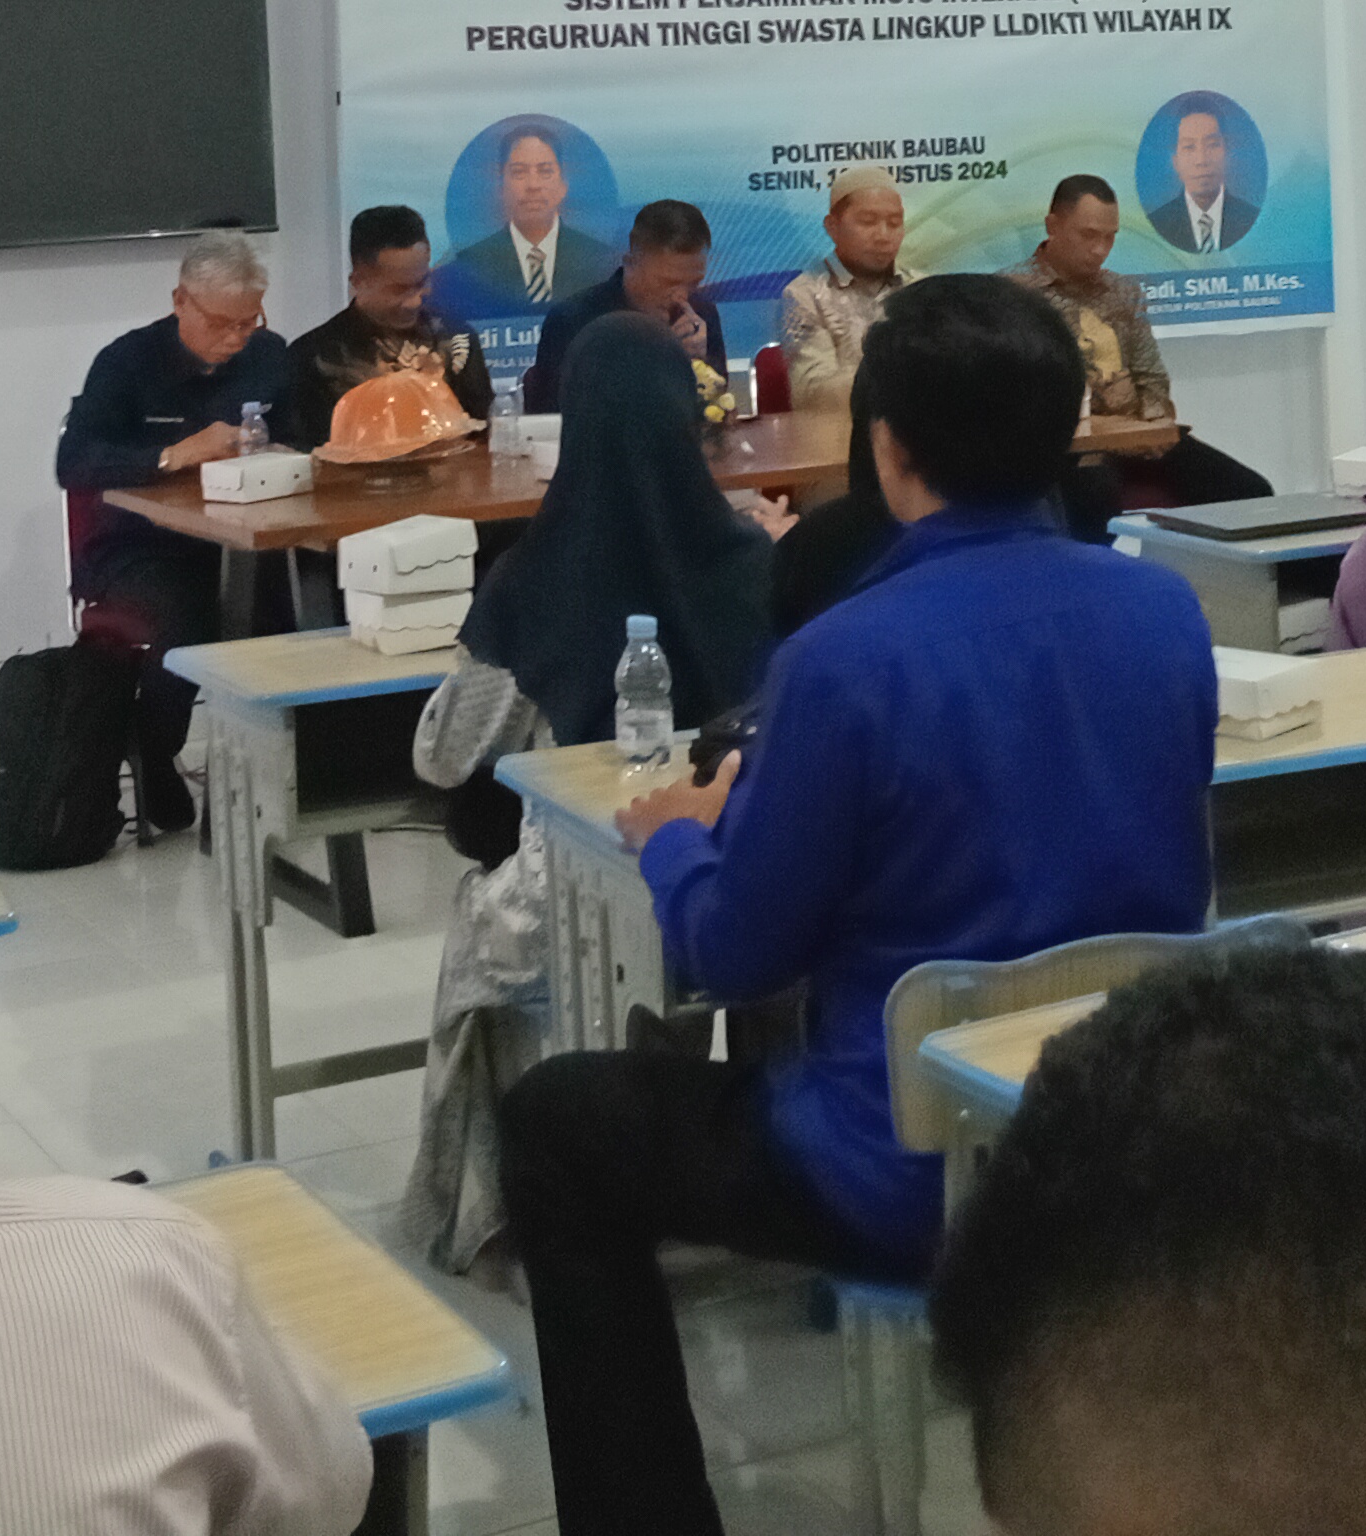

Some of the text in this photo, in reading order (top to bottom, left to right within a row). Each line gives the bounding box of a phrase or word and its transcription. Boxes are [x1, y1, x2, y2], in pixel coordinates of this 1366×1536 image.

[466, 7, 1233, 52] PERGURUAN TINGGI SWASTA LINGKUP LLDIKTI WILAYAH IX
[772, 136, 986, 165] POLITEKNIK BAUBAU
[748, 168, 822, 192] SENIN,
[957, 159, 1009, 181] 2024
[1242, 273, 1305, 293] M.Kes.
